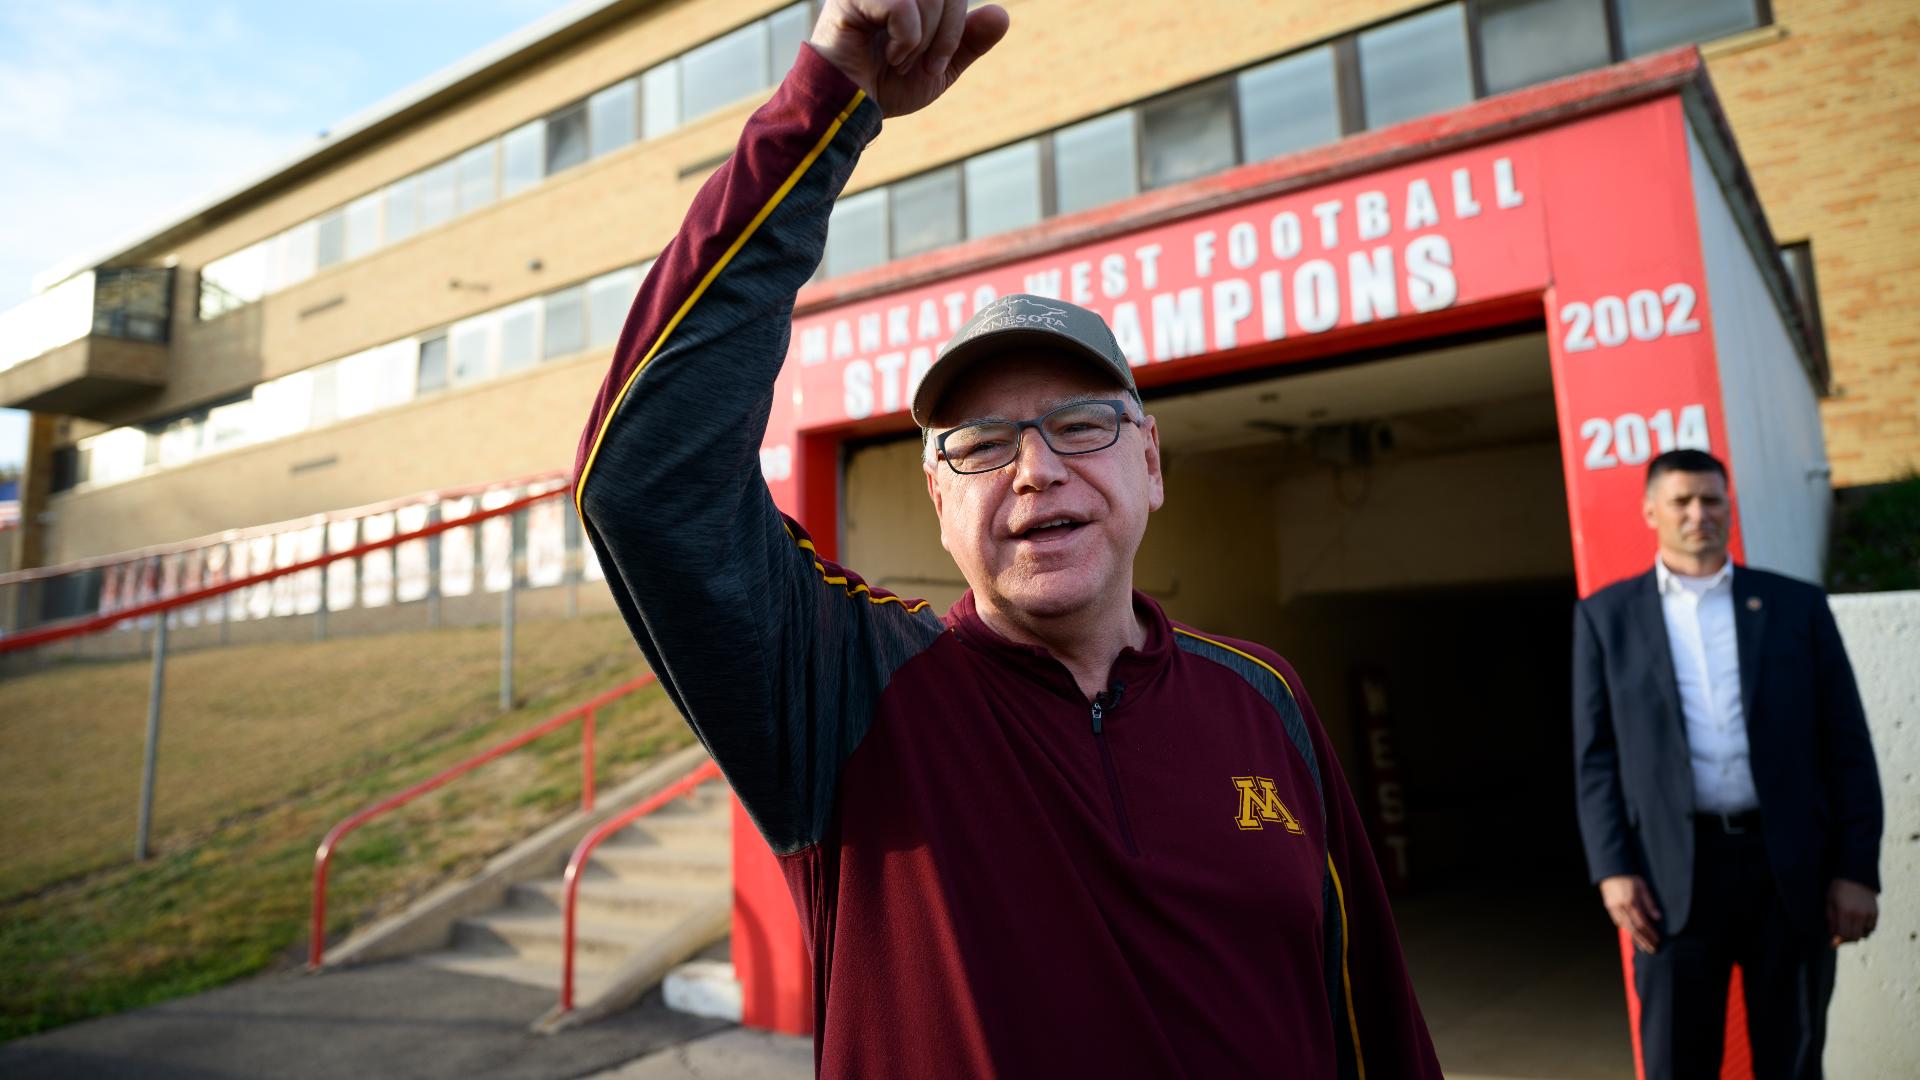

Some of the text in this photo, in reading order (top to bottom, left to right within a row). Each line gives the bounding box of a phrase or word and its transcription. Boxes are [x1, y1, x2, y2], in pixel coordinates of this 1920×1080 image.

[801, 158, 1523, 366] MANKATO WEST FOOTBALL
[1560, 282, 1700, 353] 2002
[843, 234, 1458, 420] STA AMPIONS
[1580, 404, 1711, 470] 2014
[1231, 776, 1303, 834] M
[1361, 676, 1411, 880] WEST
